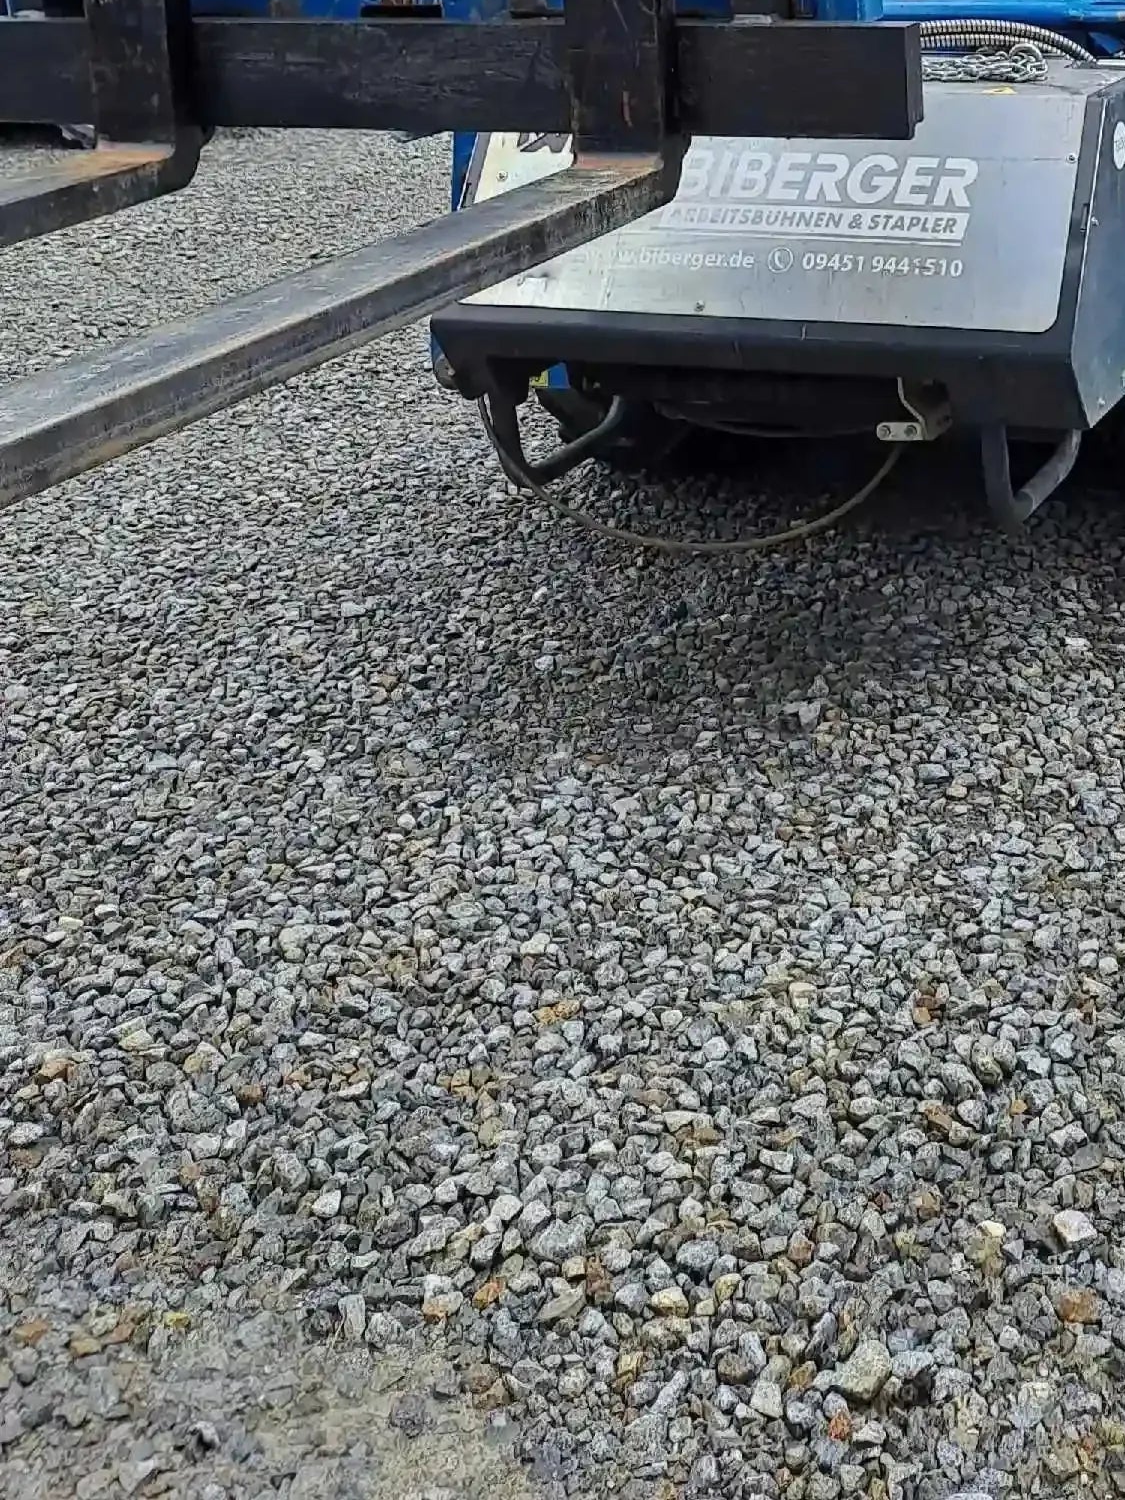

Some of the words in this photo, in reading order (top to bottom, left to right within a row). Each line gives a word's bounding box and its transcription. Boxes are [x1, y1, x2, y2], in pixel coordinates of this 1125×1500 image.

[682, 149, 979, 207] BIBERGER
[670, 205, 843, 230] ARBEITSBÜHNEN
[848, 213, 862, 230] &
[866, 214, 958, 235] STAPLER
[802, 252, 864, 273] 09451
